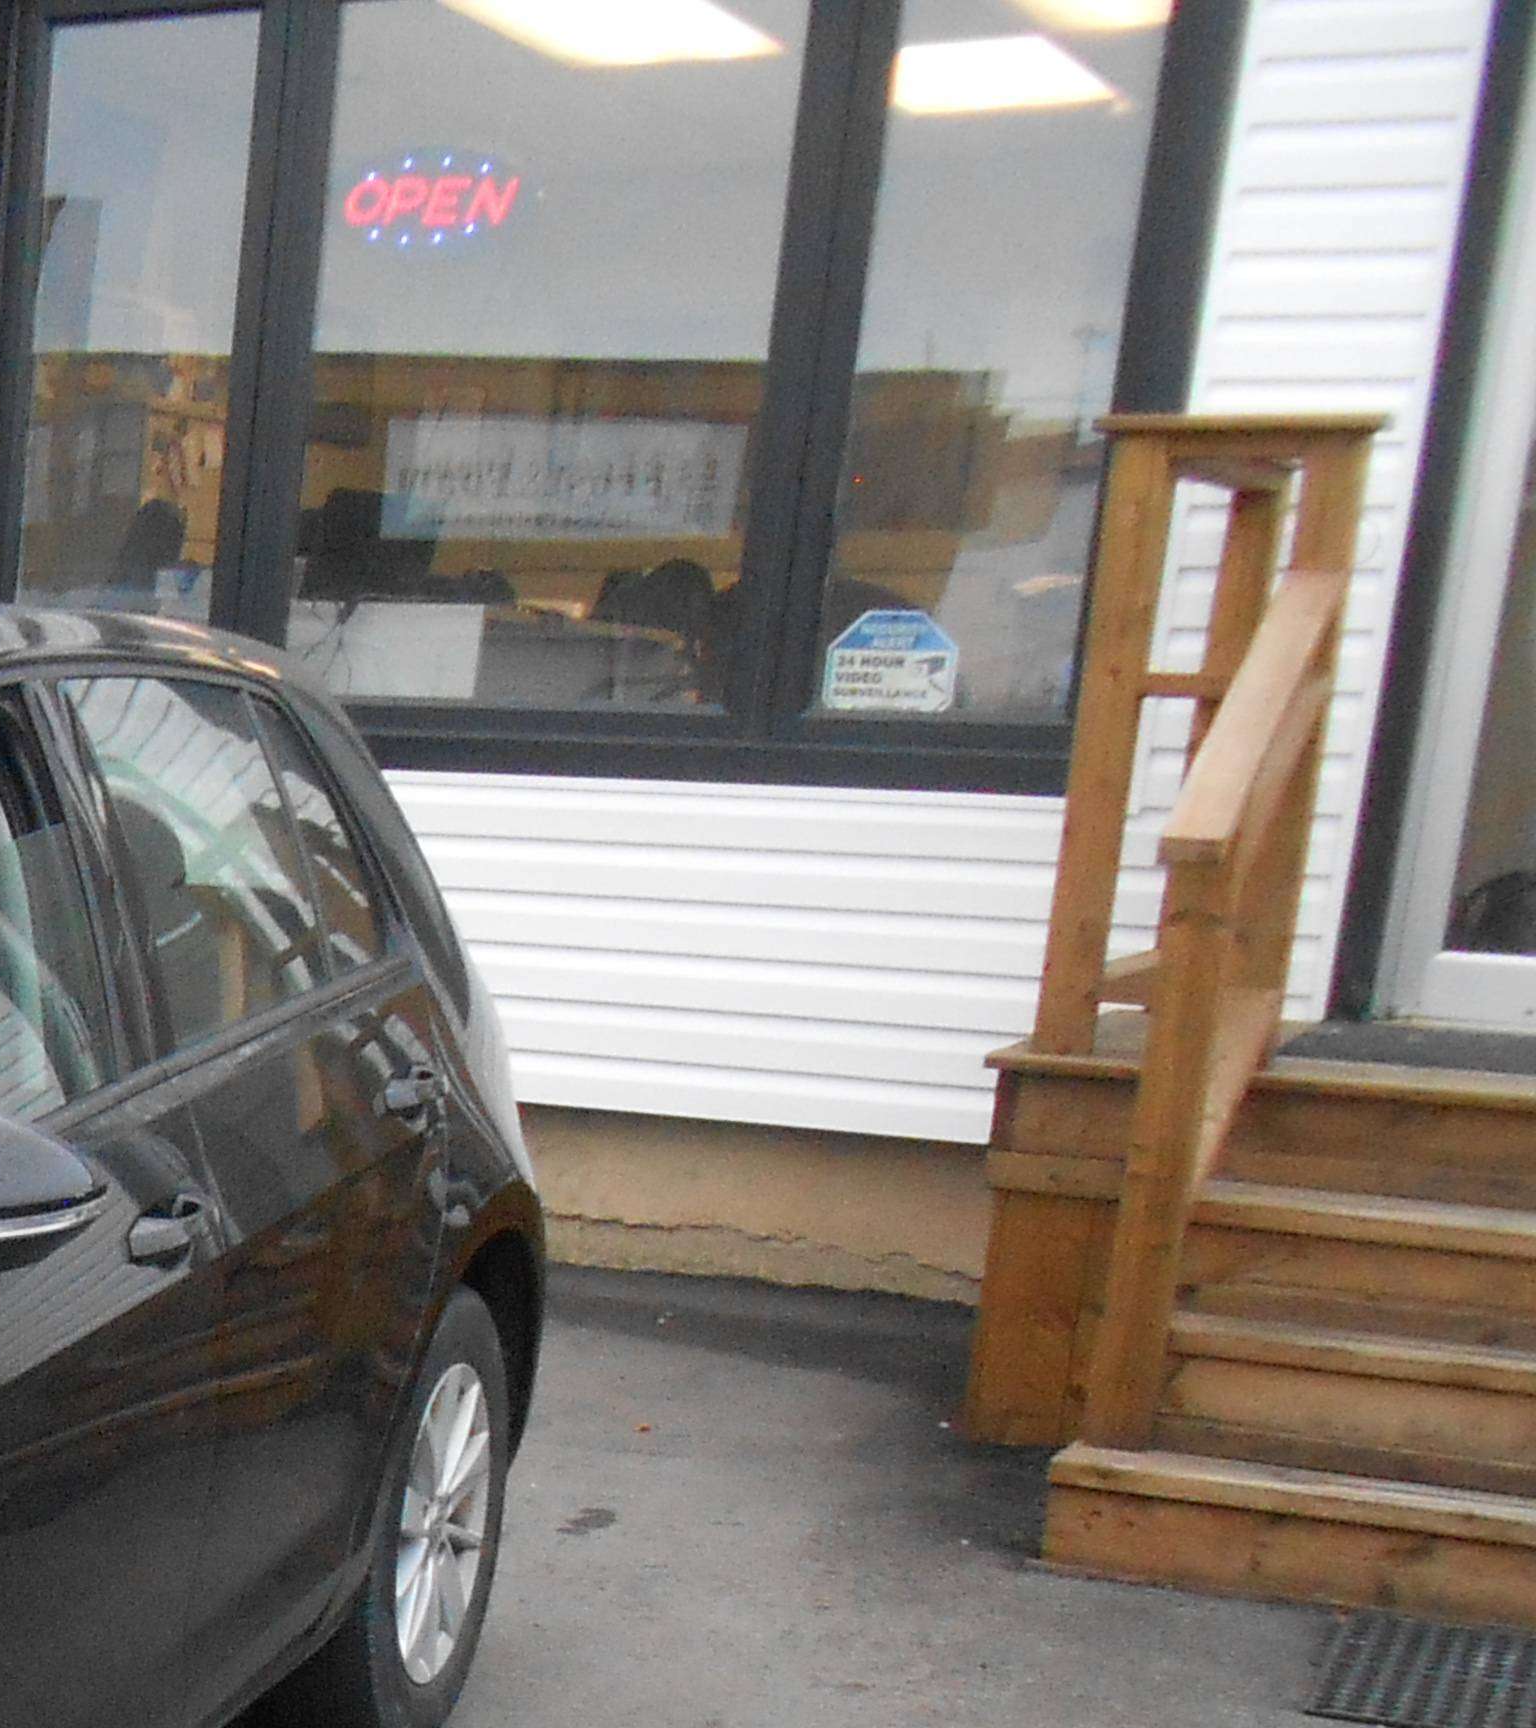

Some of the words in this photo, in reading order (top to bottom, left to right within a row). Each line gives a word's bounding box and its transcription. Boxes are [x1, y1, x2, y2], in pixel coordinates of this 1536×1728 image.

[344, 174, 521, 226] OPEN
[837, 655, 855, 668] 24
[860, 656, 906, 668] HOUR
[835, 672, 882, 684] VIDEO
